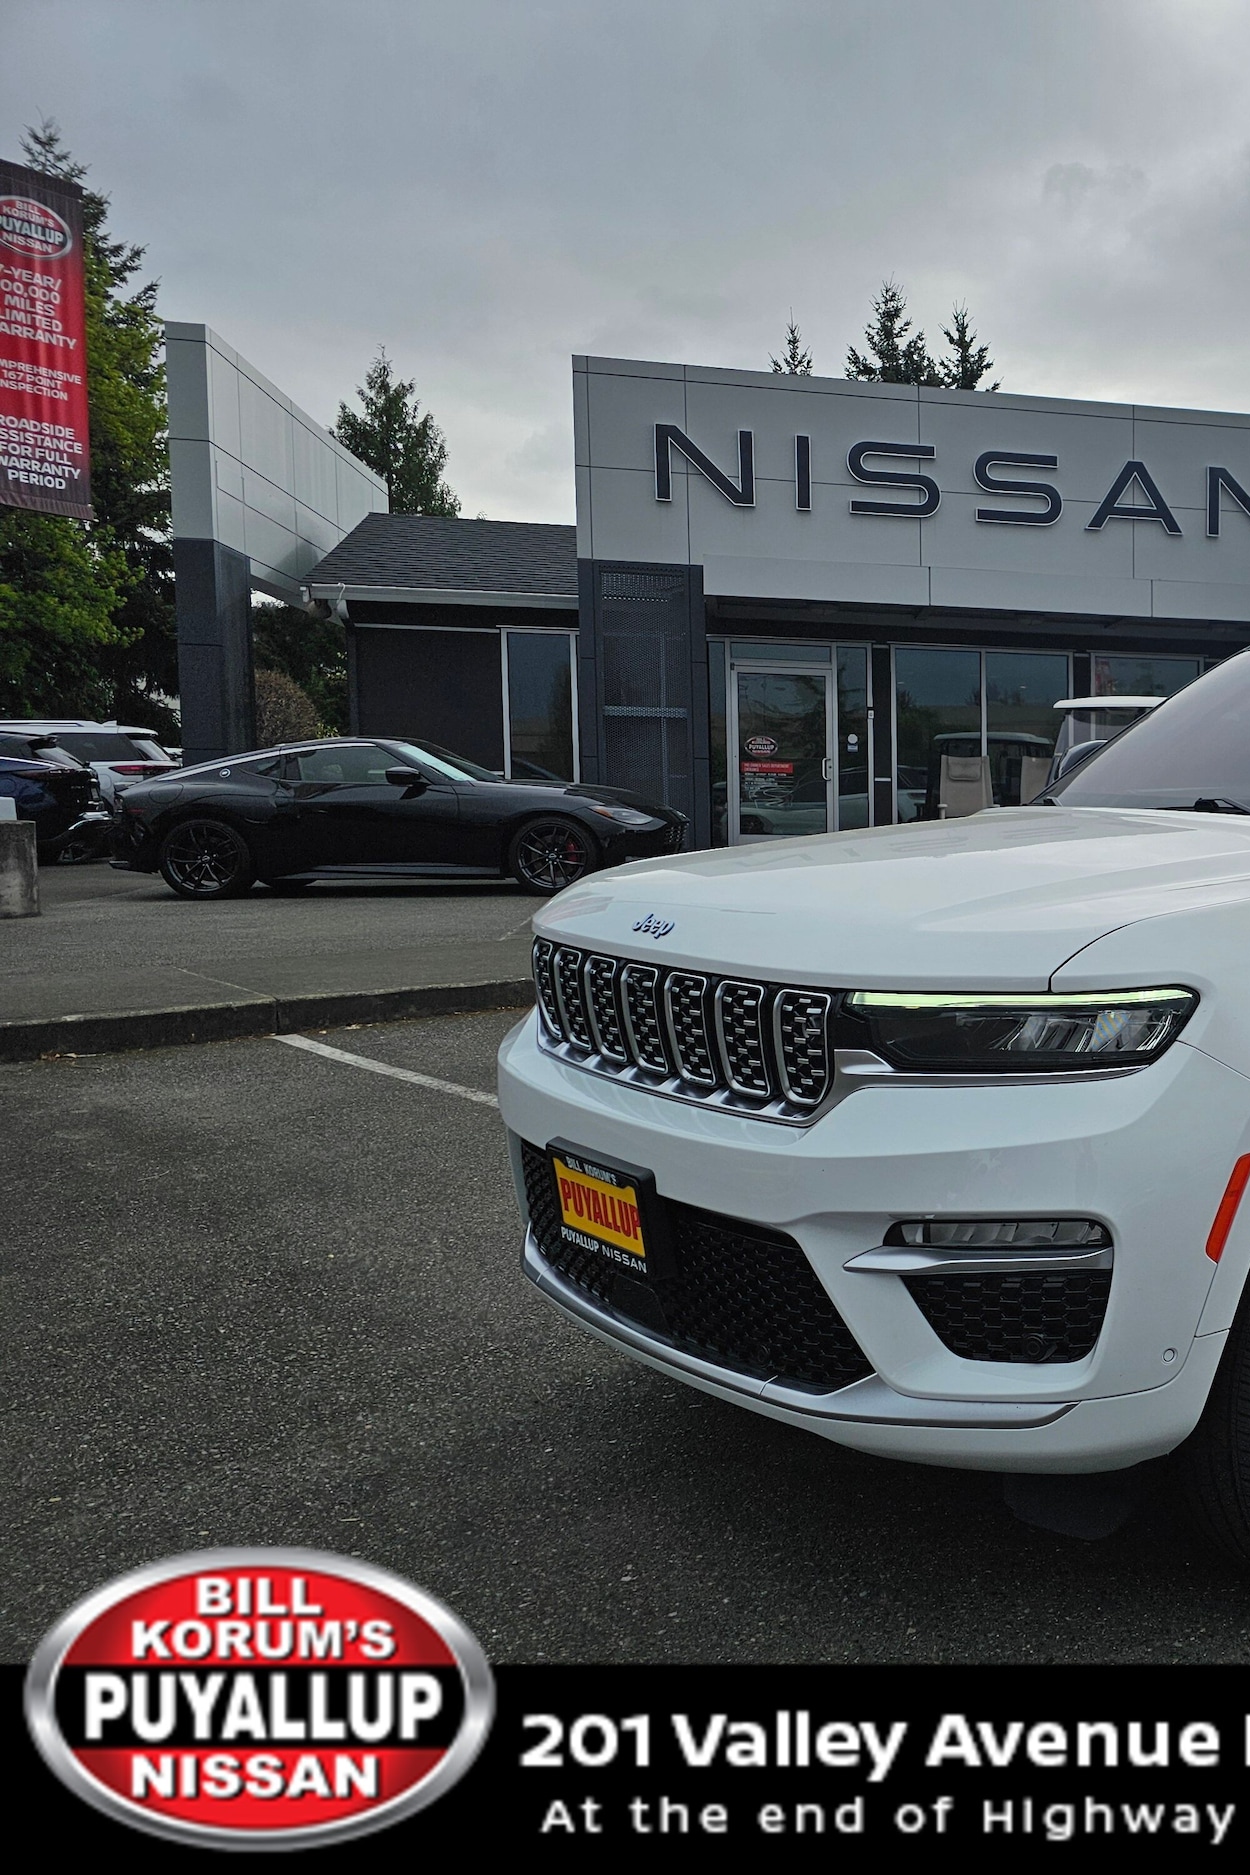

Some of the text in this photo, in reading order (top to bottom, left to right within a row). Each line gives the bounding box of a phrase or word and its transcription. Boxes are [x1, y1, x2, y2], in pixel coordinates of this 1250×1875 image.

[2, 205, 55, 227] KORUM'S
[15, 200, 42, 216] BILL
[0, 214, 64, 245] UYALLUP
[2, 232, 53, 253] NISSAN
[4, 293, 56, 317] MILES
[0, 321, 77, 350] ARRANTY
[0, 358, 82, 385] MPREHENSIVE
[1, 369, 63, 389] 167 POINT
[0, 379, 68, 401] NSPECTION
[0, 427, 83, 454] SSISTANCE
[0, 440, 72, 465] FOR FULL
[7, 469, 66, 490] PERIOD
[632, 913, 675, 939] Jeep
[565, 1156, 617, 1186] BILL KORUM'S
[559, 1177, 641, 1241] PUYALLUP
[560, 1226, 648, 1274] PUYALLUP NISSAN
